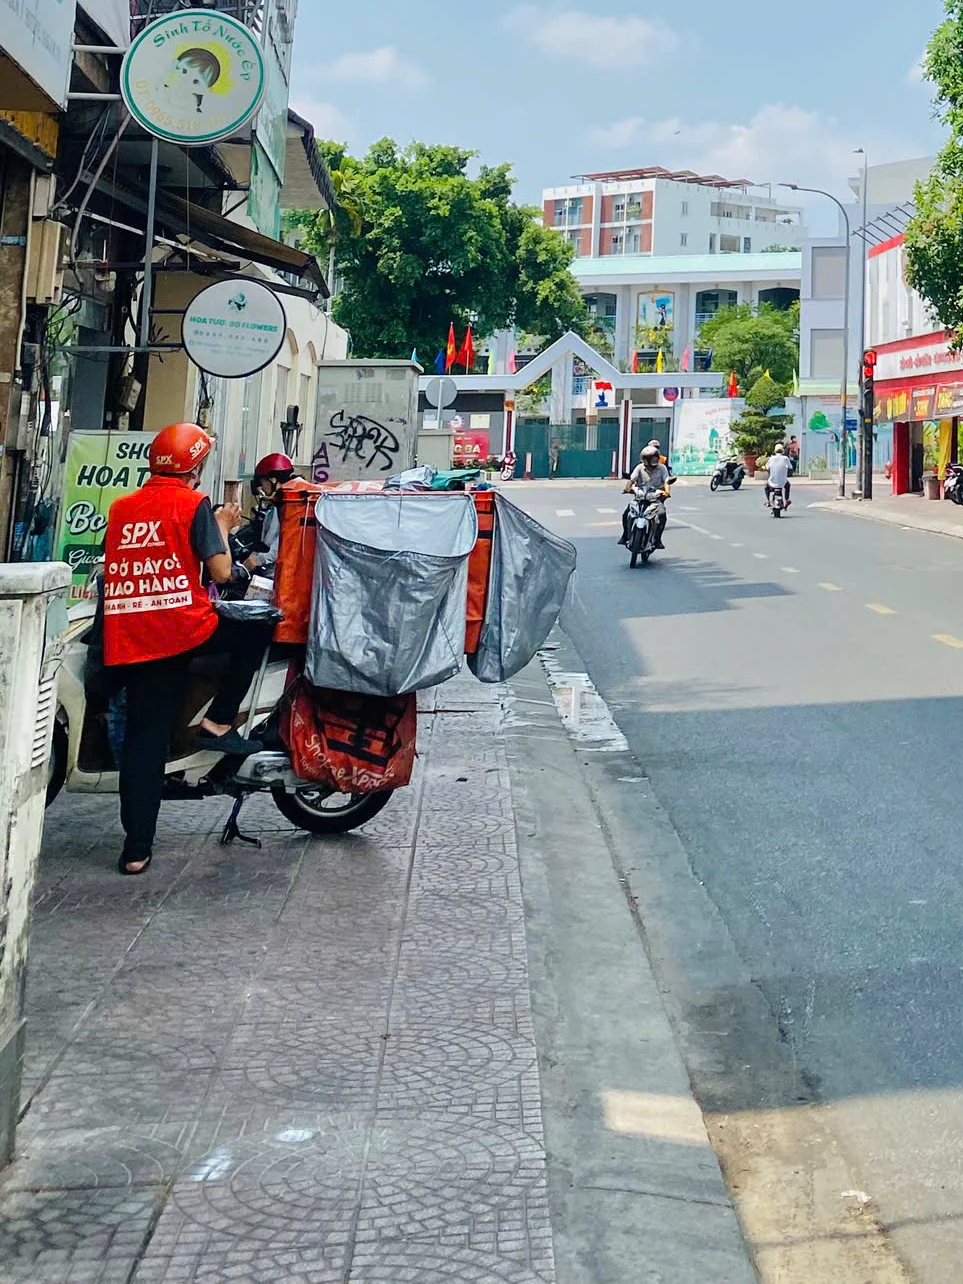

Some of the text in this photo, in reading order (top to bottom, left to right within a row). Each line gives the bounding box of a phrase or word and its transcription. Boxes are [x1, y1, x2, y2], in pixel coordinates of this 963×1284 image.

[153, 23, 188, 48] Sinh
[192, 19, 211, 32] Tố
[213, 26, 245, 56] Nước
[190, 437, 206, 459] SPX
[156, 454, 172, 465] SPX
[77, 465, 130, 488] HOA
[121, 521, 161, 547] SPX
[104, 575, 189, 597] GIAO HÀNG
